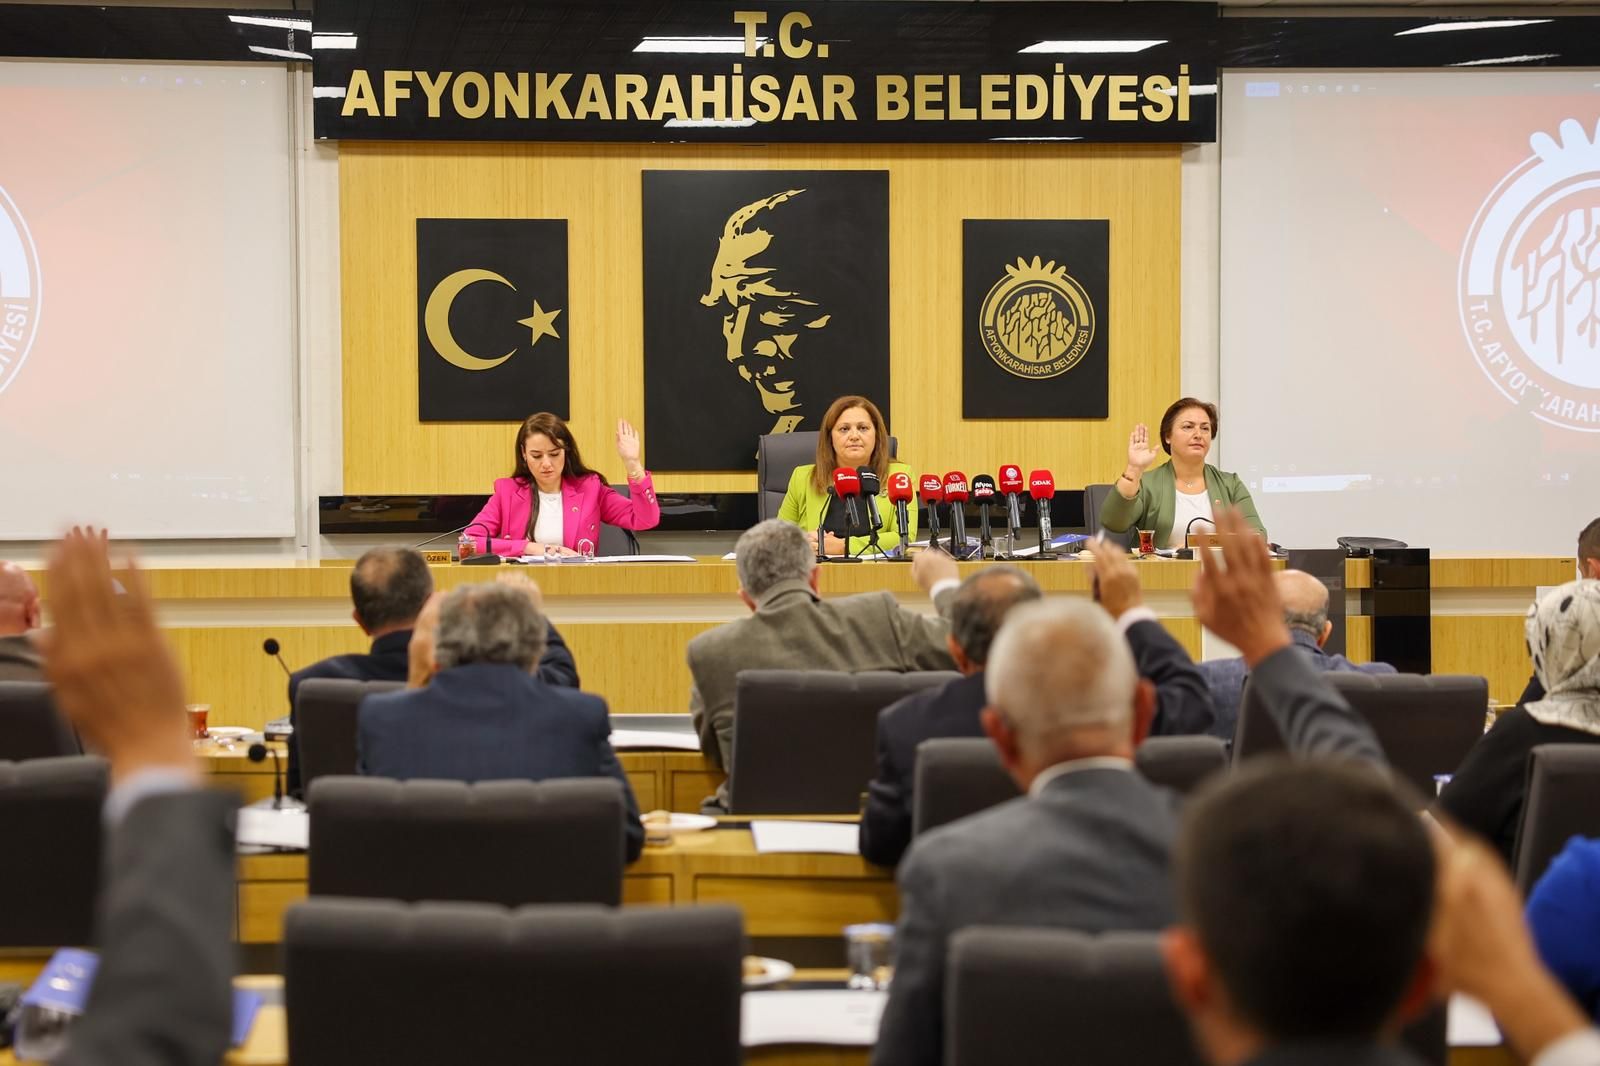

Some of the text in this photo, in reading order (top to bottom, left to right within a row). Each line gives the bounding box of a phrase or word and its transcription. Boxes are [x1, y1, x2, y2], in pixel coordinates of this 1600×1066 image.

[733, 11, 829, 58] T.C.
[341, 63, 1191, 122] AFYONKARAHİSAR BELEDİYESİ
[985, 329, 1089, 375] AFYONKARAHİSAR BELEDİYESİ
[896, 474, 909, 489] 3
